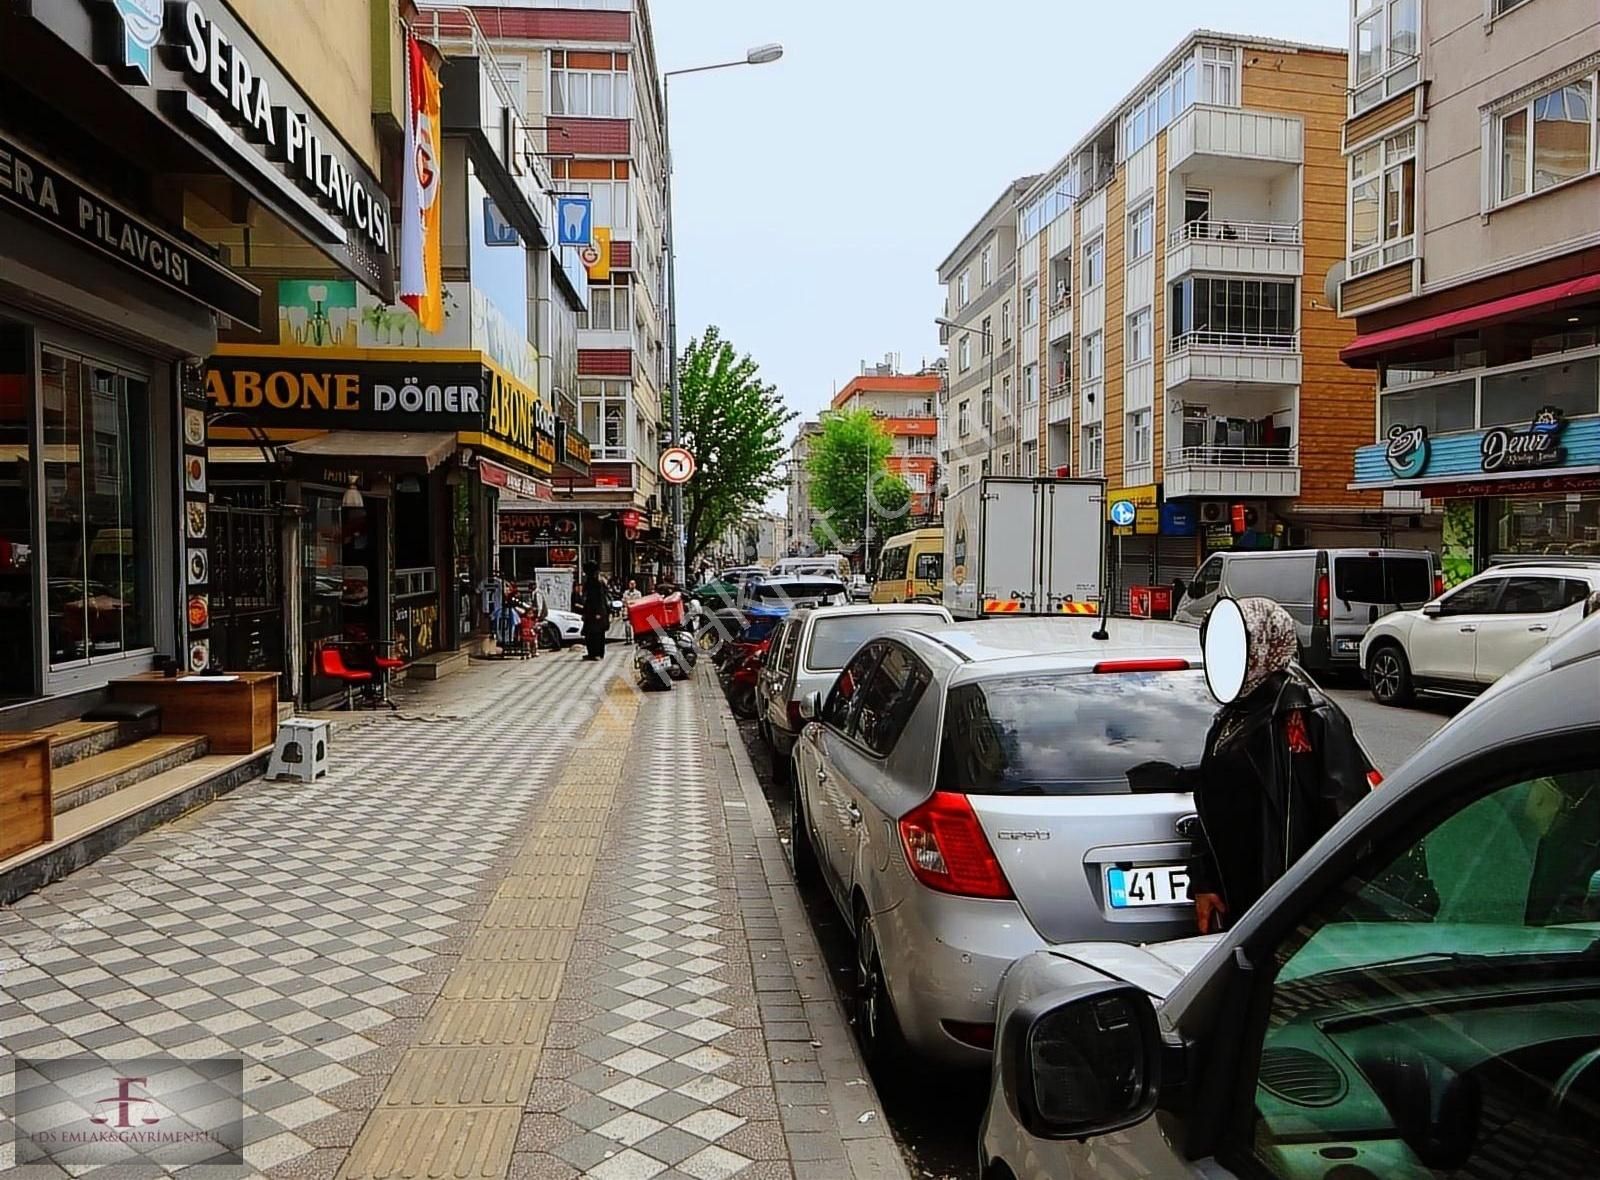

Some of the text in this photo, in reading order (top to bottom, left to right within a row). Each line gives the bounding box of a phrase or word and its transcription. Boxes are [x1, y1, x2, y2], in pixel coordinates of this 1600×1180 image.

[185, 1, 276, 145] SERA
[206, 370, 480, 412] ABONE DÖNER
[489, 371, 534, 450] ABONE
[1128, 872, 1156, 901] 41
